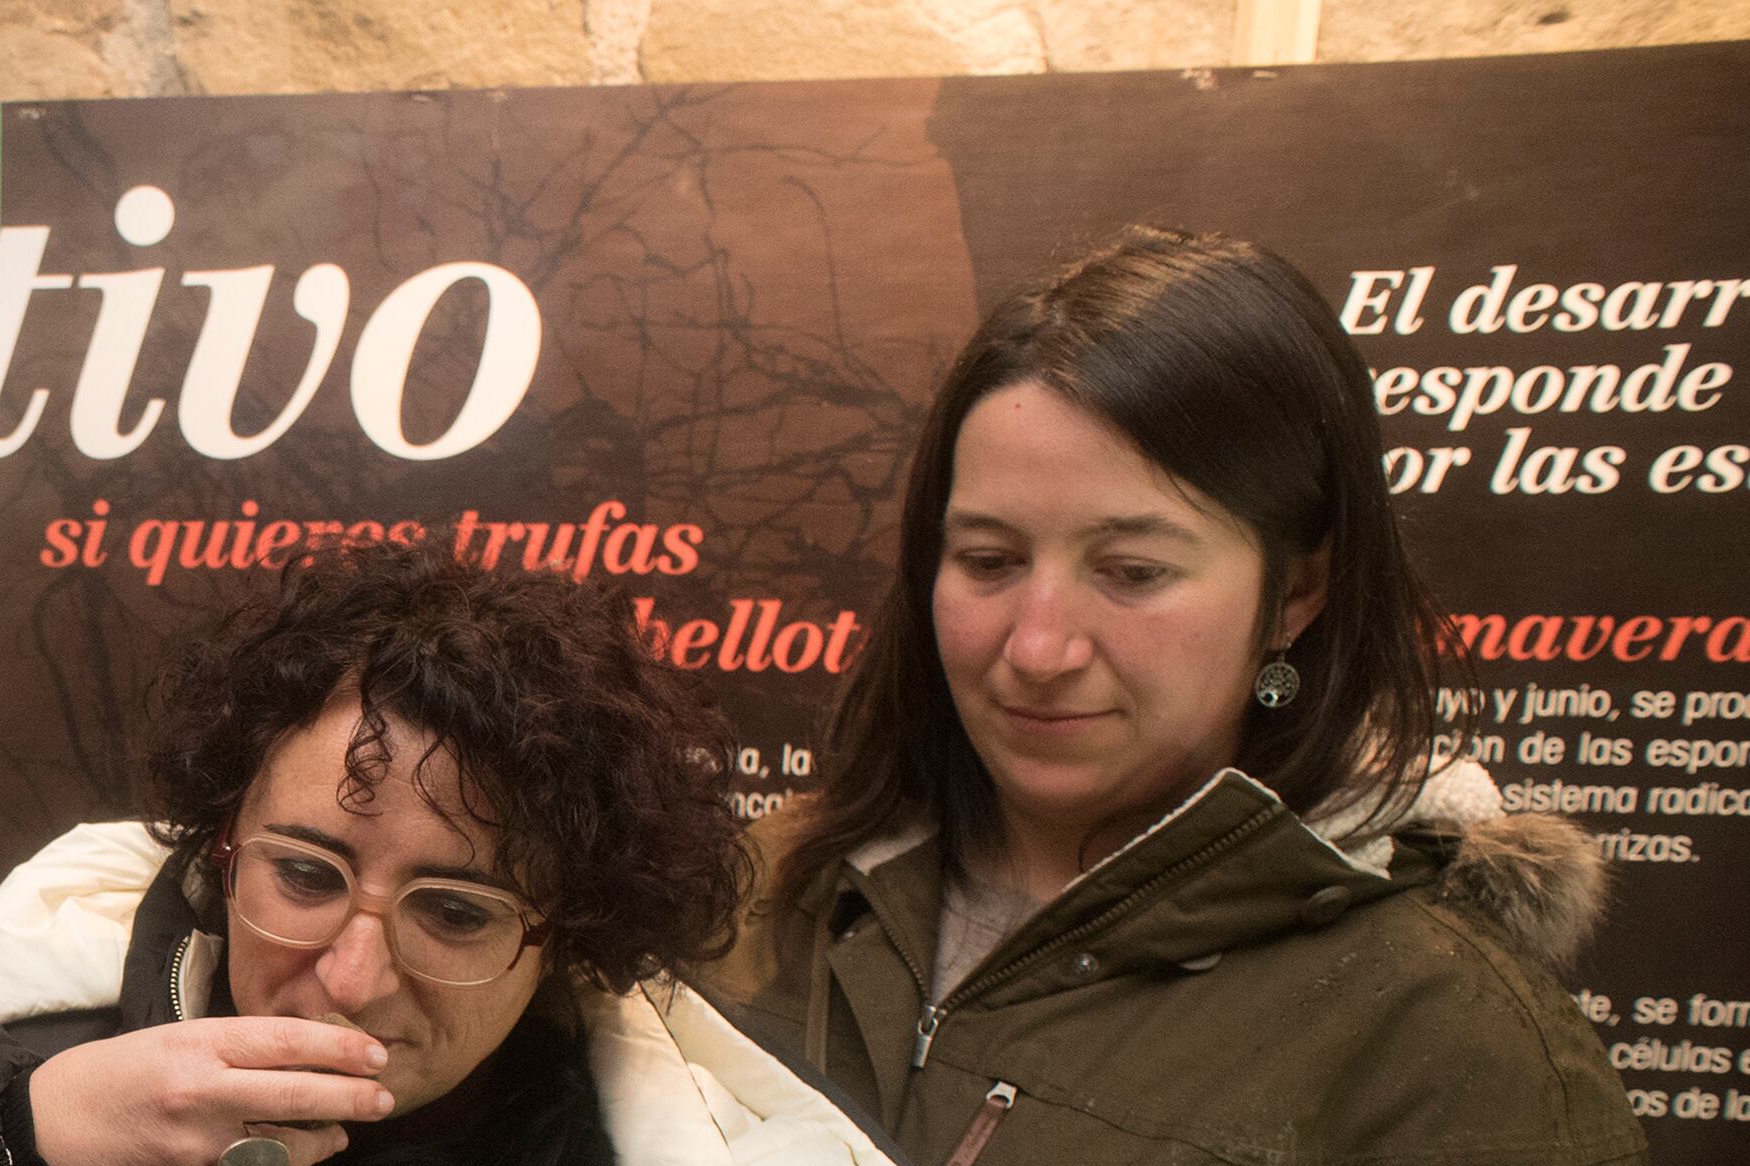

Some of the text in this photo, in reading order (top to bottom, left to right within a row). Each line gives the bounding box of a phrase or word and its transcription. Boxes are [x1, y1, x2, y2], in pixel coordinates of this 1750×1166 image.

[1340, 265, 1436, 335] El
[1369, 343, 1733, 431] esponde
[1489, 427, 1627, 494] las
[1648, 444, 1750, 494] es
[40, 500, 108, 569] si
[453, 500, 703, 585] trufas
[630, 597, 870, 674] bellot
[1493, 688, 1518, 724] y
[1519, 682, 1621, 725] junio,
[1630, 690, 1676, 719] se
[1518, 730, 1566, 765] de
[1577, 731, 1634, 766] las
[1501, 778, 1638, 814] sistema
[1633, 997, 1679, 1025] se
[1610, 1036, 1733, 1074] células
[1674, 1087, 1720, 1120] de
